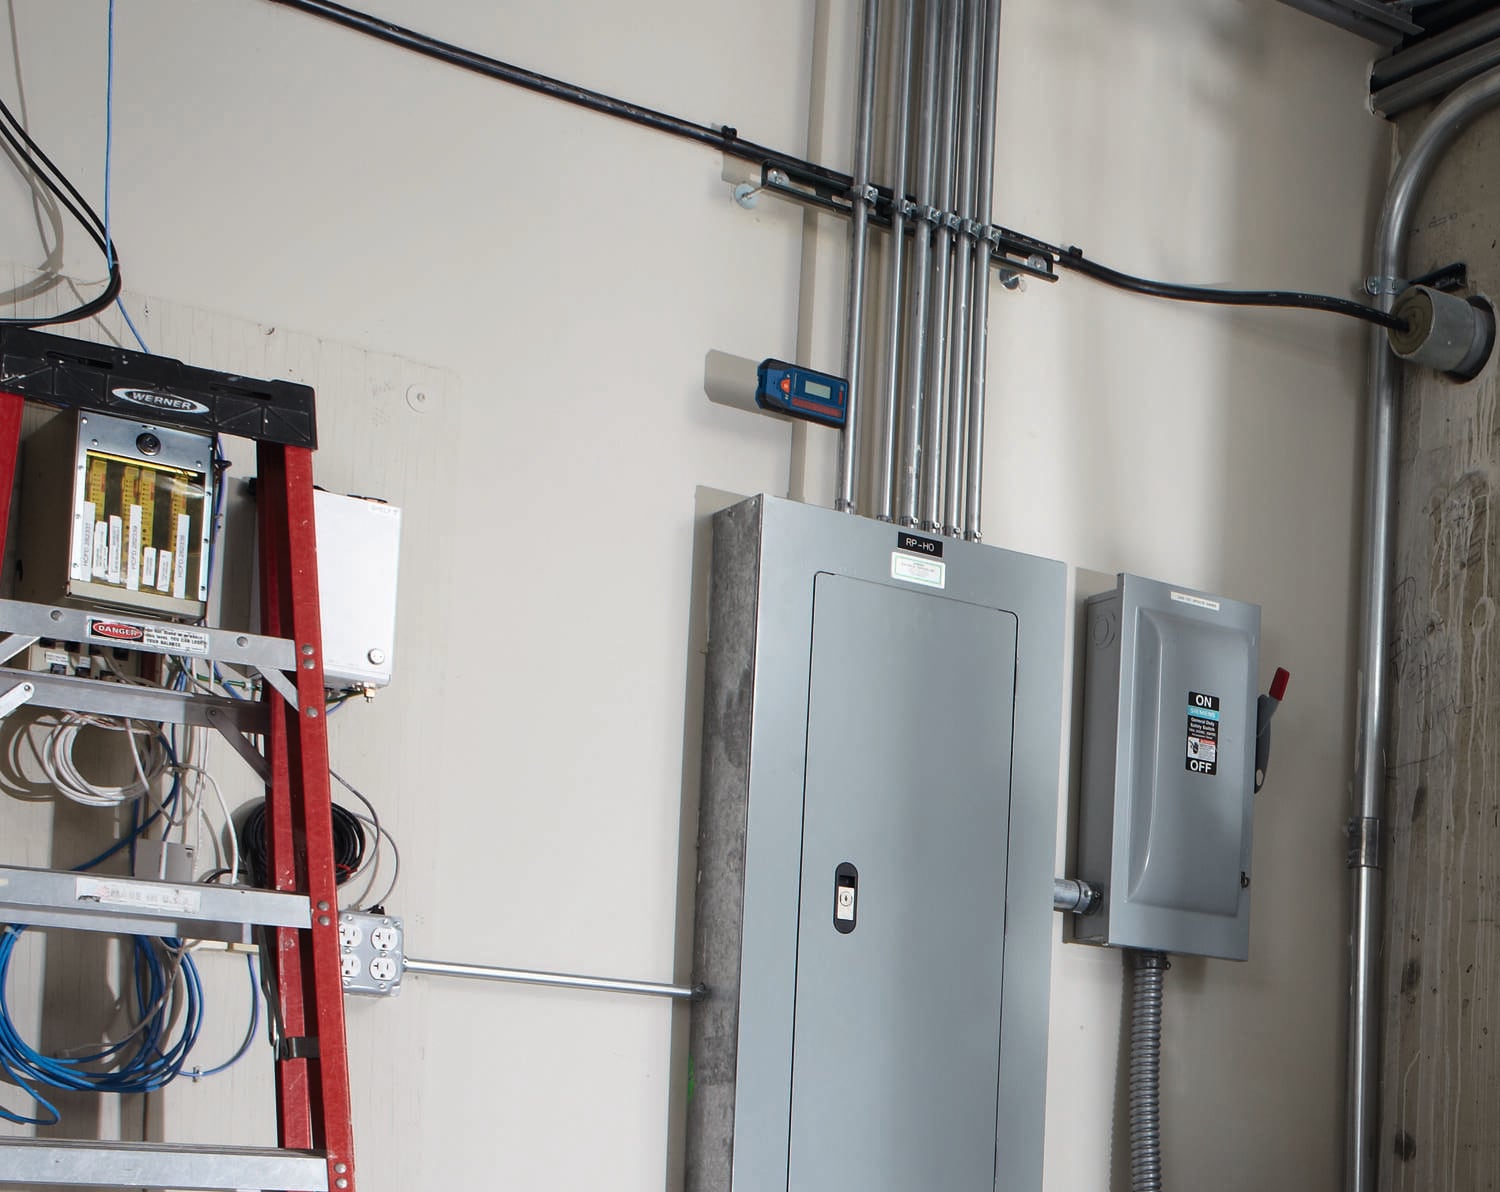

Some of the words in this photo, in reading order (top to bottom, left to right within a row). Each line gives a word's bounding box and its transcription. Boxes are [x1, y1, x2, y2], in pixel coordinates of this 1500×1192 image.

[131, 391, 193, 411] WERNER
[98, 624, 137, 636] DANGER
[1196, 694, 1212, 708] ON
[1190, 760, 1212, 773] OFF
